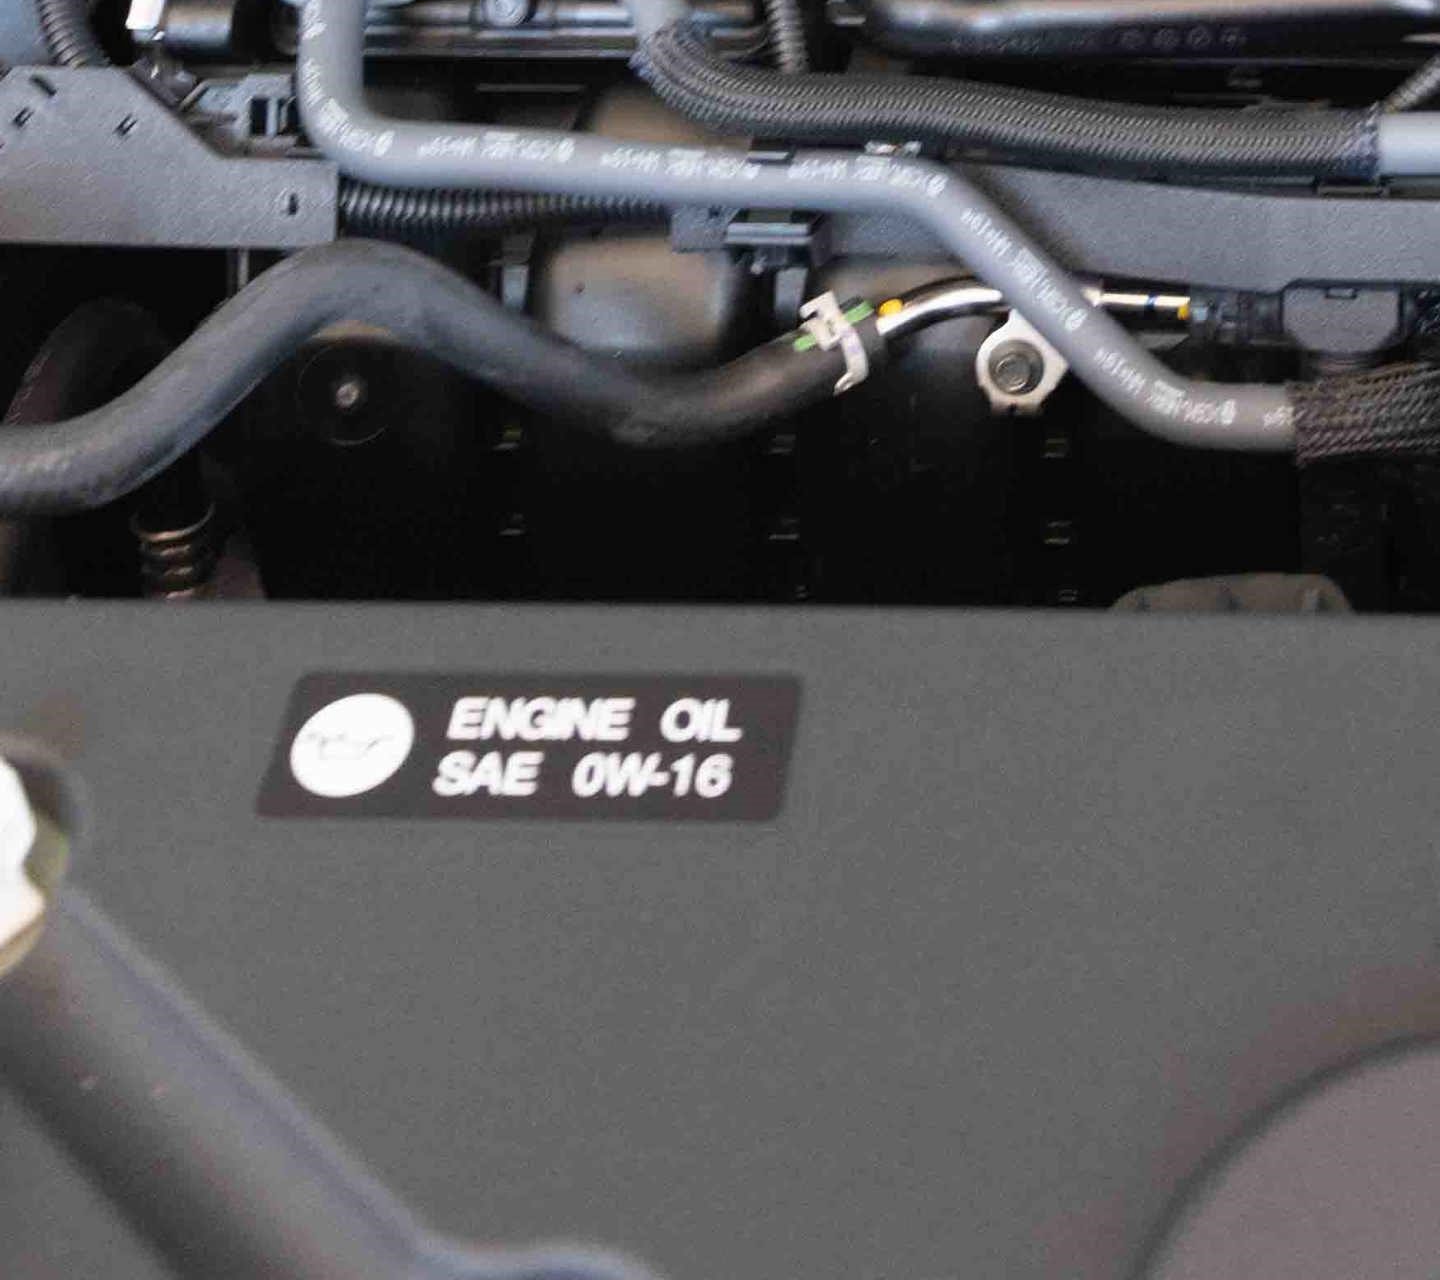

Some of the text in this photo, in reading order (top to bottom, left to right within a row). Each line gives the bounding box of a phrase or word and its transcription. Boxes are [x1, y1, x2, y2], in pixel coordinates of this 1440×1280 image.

[447, 697, 741, 742] ENGINE OIL
[433, 751, 732, 797] SAE 0W-16
